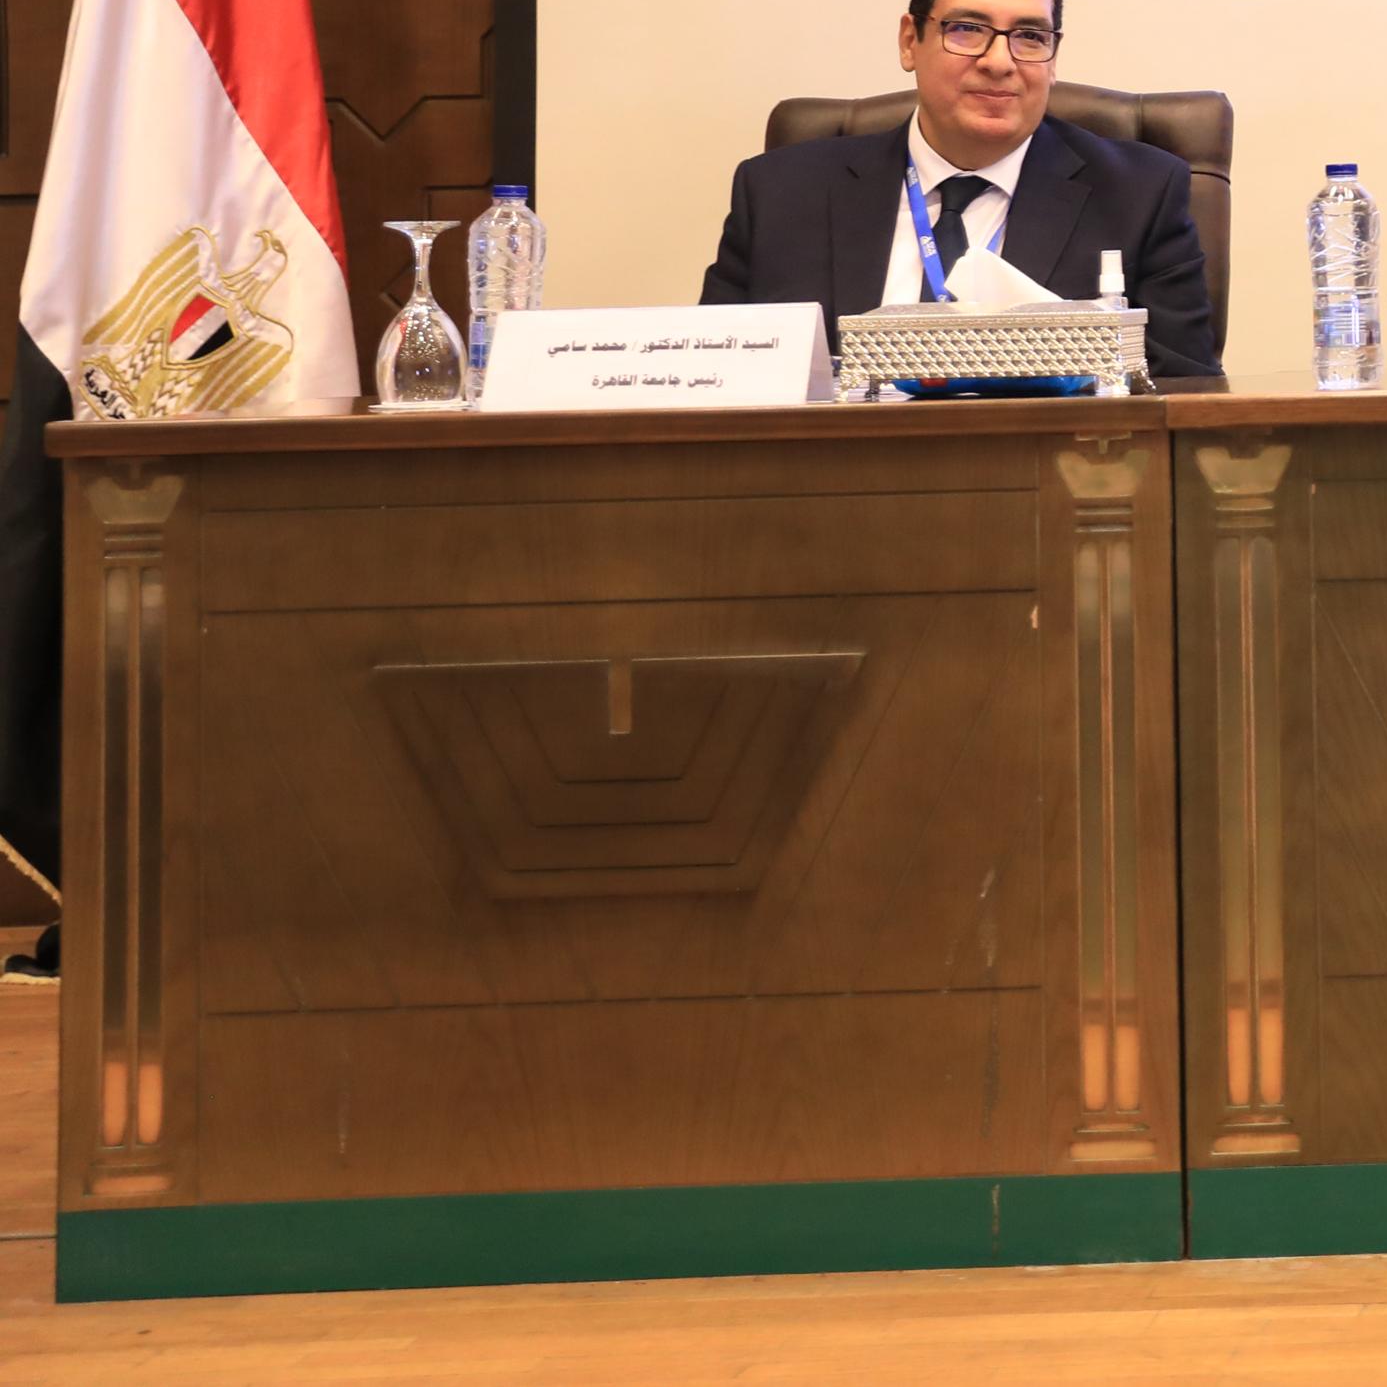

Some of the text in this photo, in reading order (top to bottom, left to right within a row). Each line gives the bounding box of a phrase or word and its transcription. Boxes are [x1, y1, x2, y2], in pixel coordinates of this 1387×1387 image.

[547, 341, 587, 358] سامي
[591, 342, 627, 351] محمد
[640, 338, 690, 353] الدكتور
[742, 338, 779, 352] السيد
[592, 373, 723, 389] رئيس جامعة القاهرة
